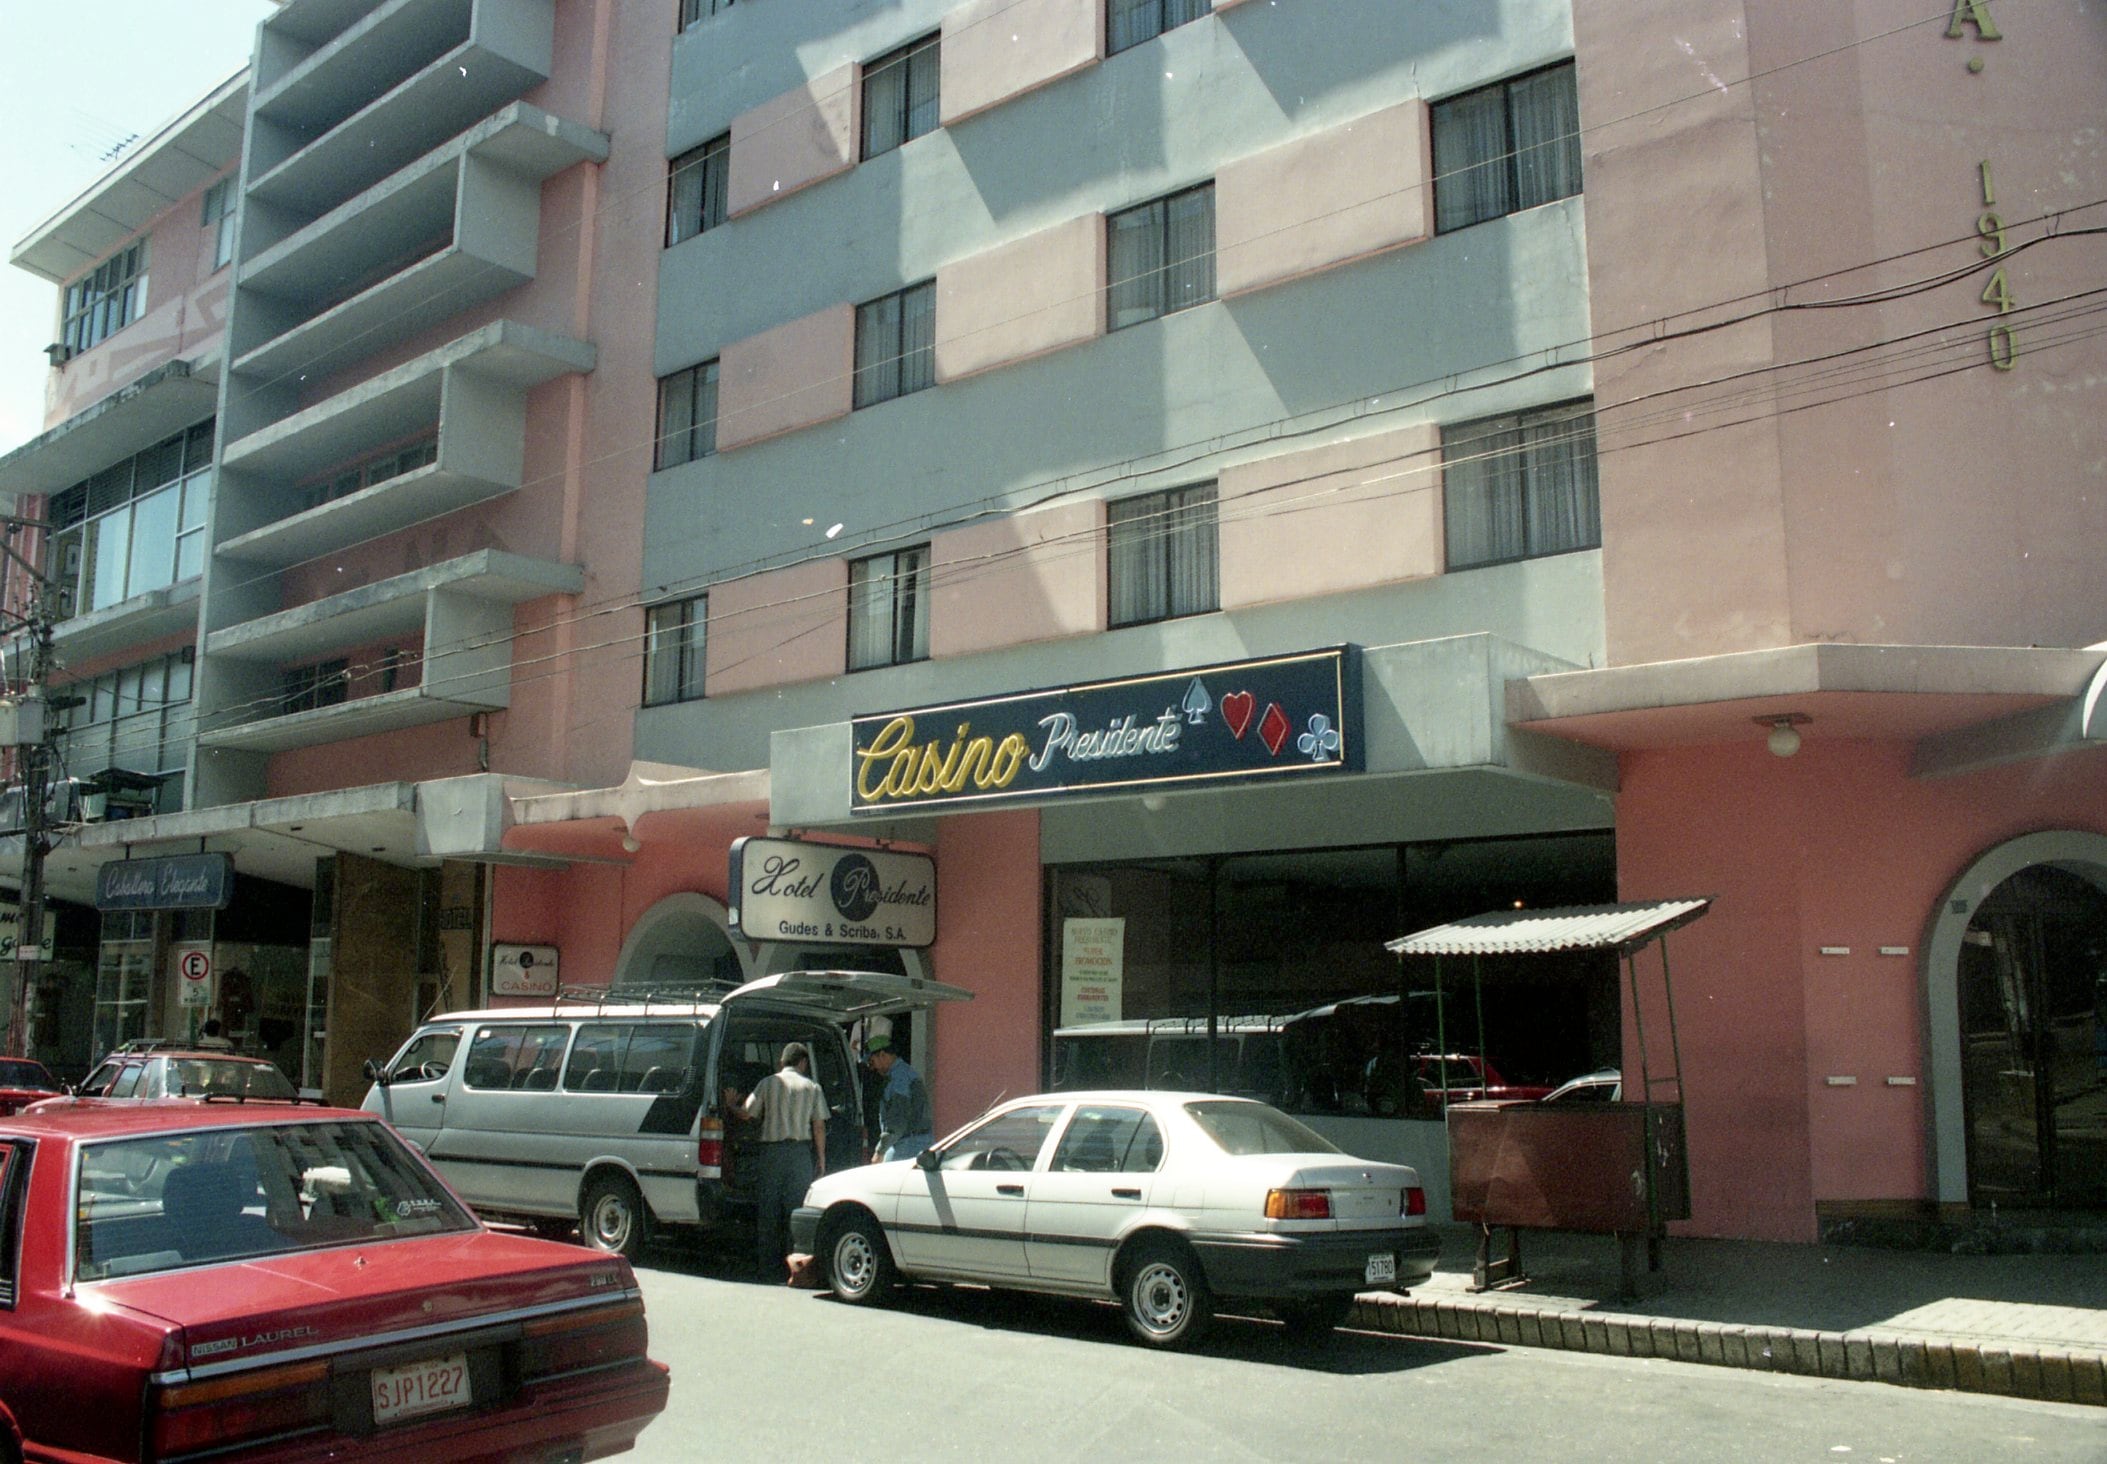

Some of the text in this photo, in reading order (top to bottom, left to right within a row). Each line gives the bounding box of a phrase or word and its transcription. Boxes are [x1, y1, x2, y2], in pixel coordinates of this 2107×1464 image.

[857, 706, 1181, 801] Casino Presidente
[751, 856, 931, 908] Hotel Presidente
[779, 920, 907, 941] Gudes & Scriba, S.A.
[191, 957, 201, 975] E
[501, 981, 552, 992] CASINO
[193, 1326, 319, 1355] NISSAN LAUREL
[378, 1366, 463, 1410] SJP1227
